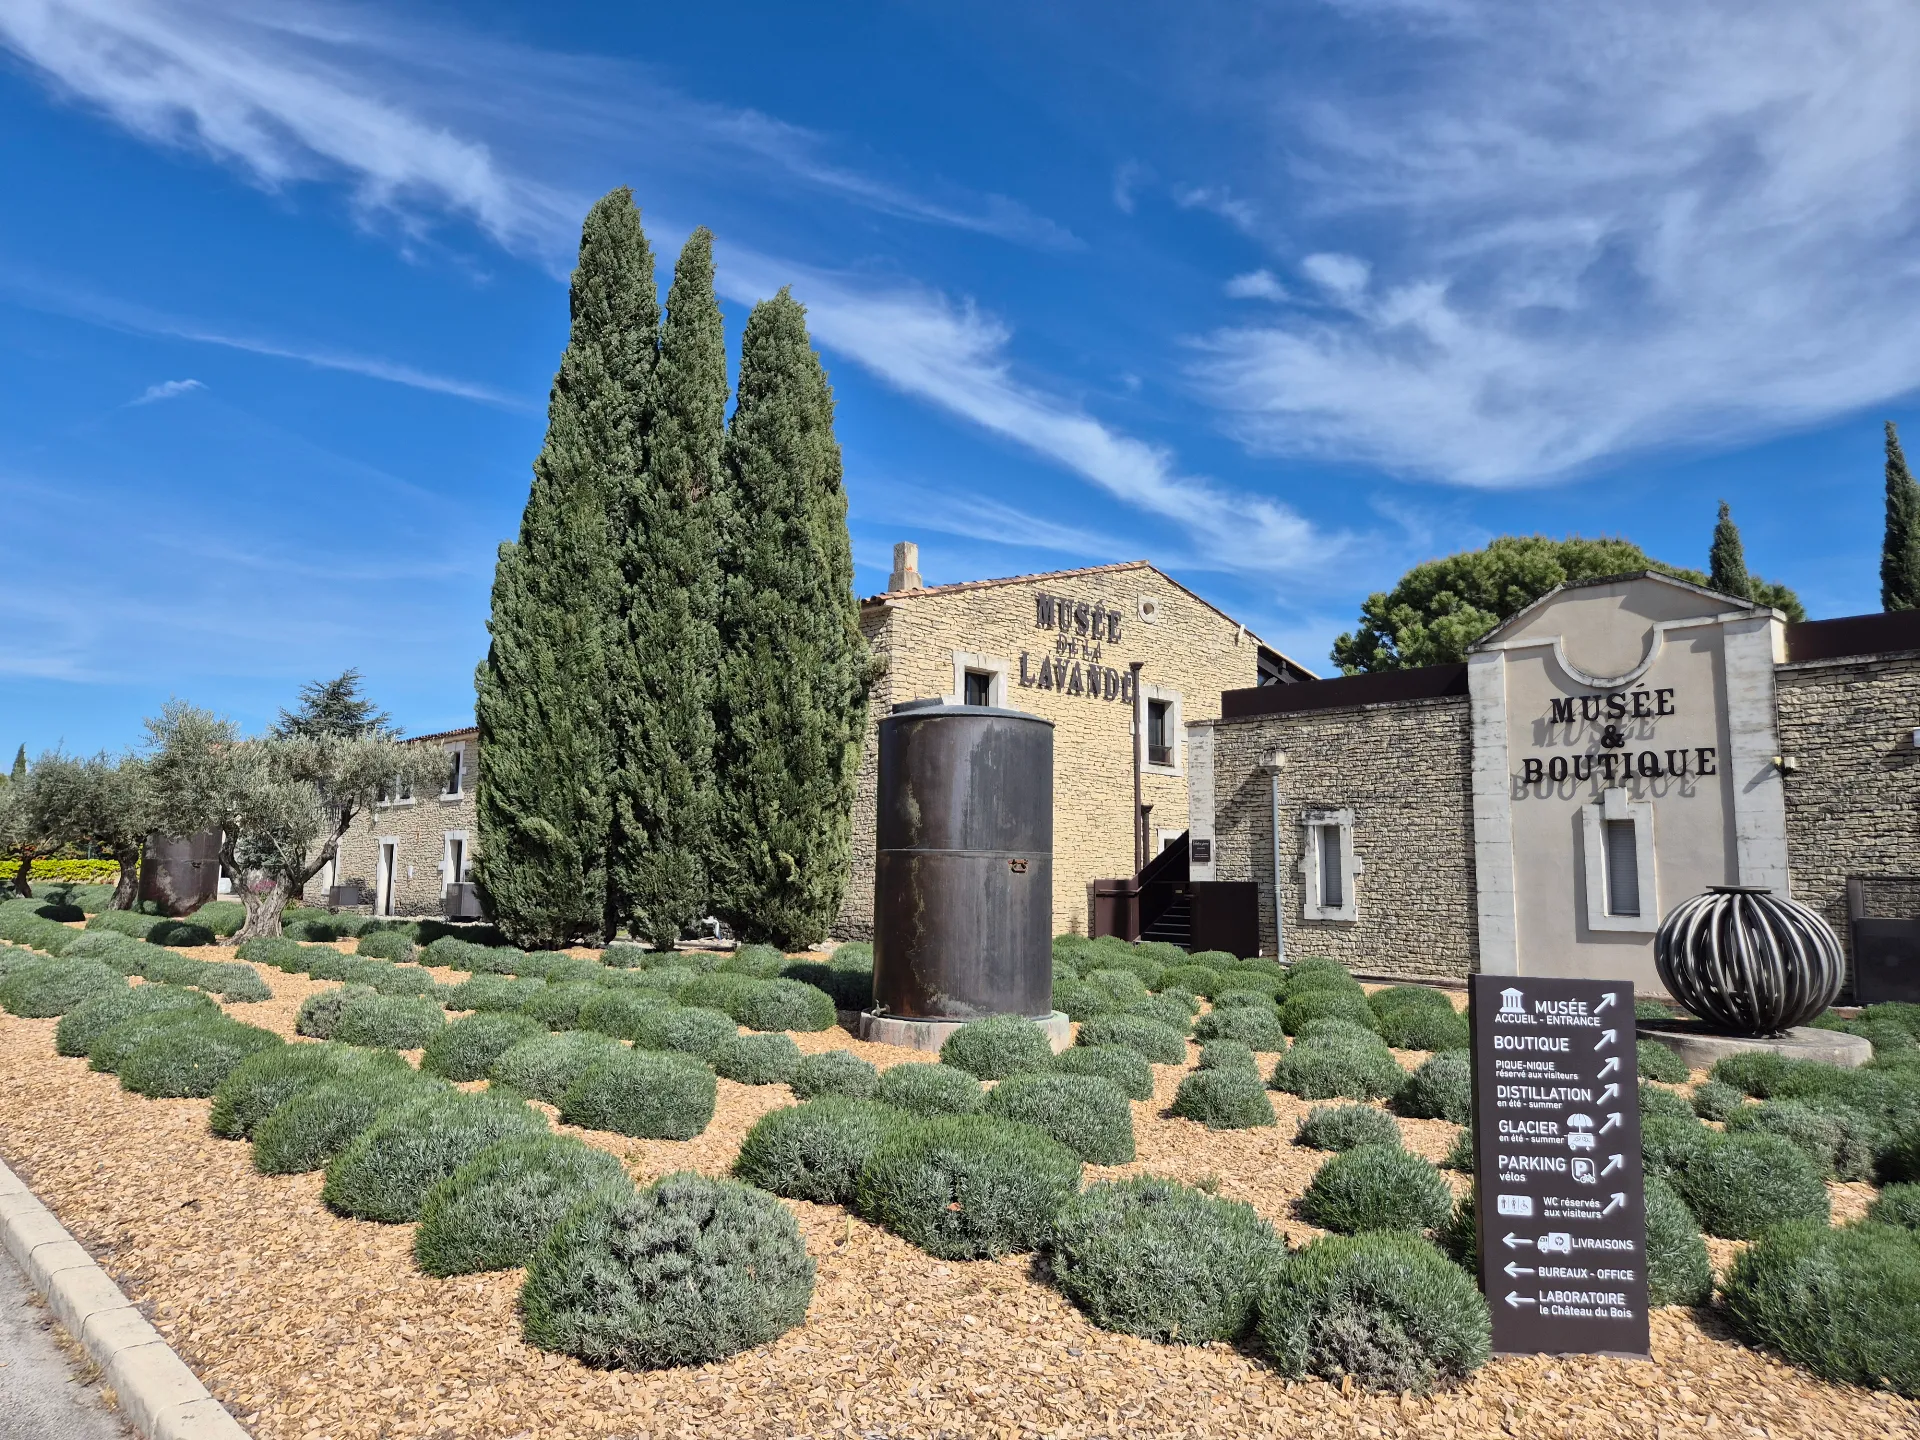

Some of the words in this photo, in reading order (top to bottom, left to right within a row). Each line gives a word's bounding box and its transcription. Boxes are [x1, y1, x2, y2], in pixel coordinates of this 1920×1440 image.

[1036, 592, 1121, 643] MUSÉE
[1057, 634, 1078, 658] DE
[1550, 683, 1674, 723] MUSÉE
[1601, 725, 1625, 748] &
[1523, 748, 1716, 783] BOUTIQUE
[1535, 999, 1587, 1015] MUSÉE
[1495, 1013, 1537, 1024] ACCUEIL
[1547, 1016, 1601, 1026] ENTRANCE
[1494, 1036, 1570, 1051] BOUTIQUE
[1496, 1060, 1555, 1071] PIQUE-NIQUE
[1496, 1070, 1526, 1078] réservé
[1497, 1085, 1591, 1101] DISTILLATION
[1509, 1100, 1521, 1108] été
[1499, 1120, 1558, 1134] GLACIER
[1511, 1134, 1523, 1142] été
[1531, 1136, 1564, 1144] summer
[1498, 1155, 1566, 1171] PARKING
[1499, 1172, 1525, 1182] vélos
[1543, 1197, 1558, 1206] WC
[1560, 1197, 1600, 1208] réservés
[1562, 1209, 1601, 1218] visiteurs
[1572, 1238, 1633, 1250] LIVRAISONS
[1538, 1267, 1587, 1278] BUREAUX
[1597, 1269, 1634, 1280] OFFICE
[1540, 1290, 1625, 1305] LABORATOIRE
[1540, 1305, 1549, 1315] le
[1551, 1306, 1592, 1316] Château
[1595, 1307, 1607, 1317] du
[1610, 1308, 1632, 1318] Bois
